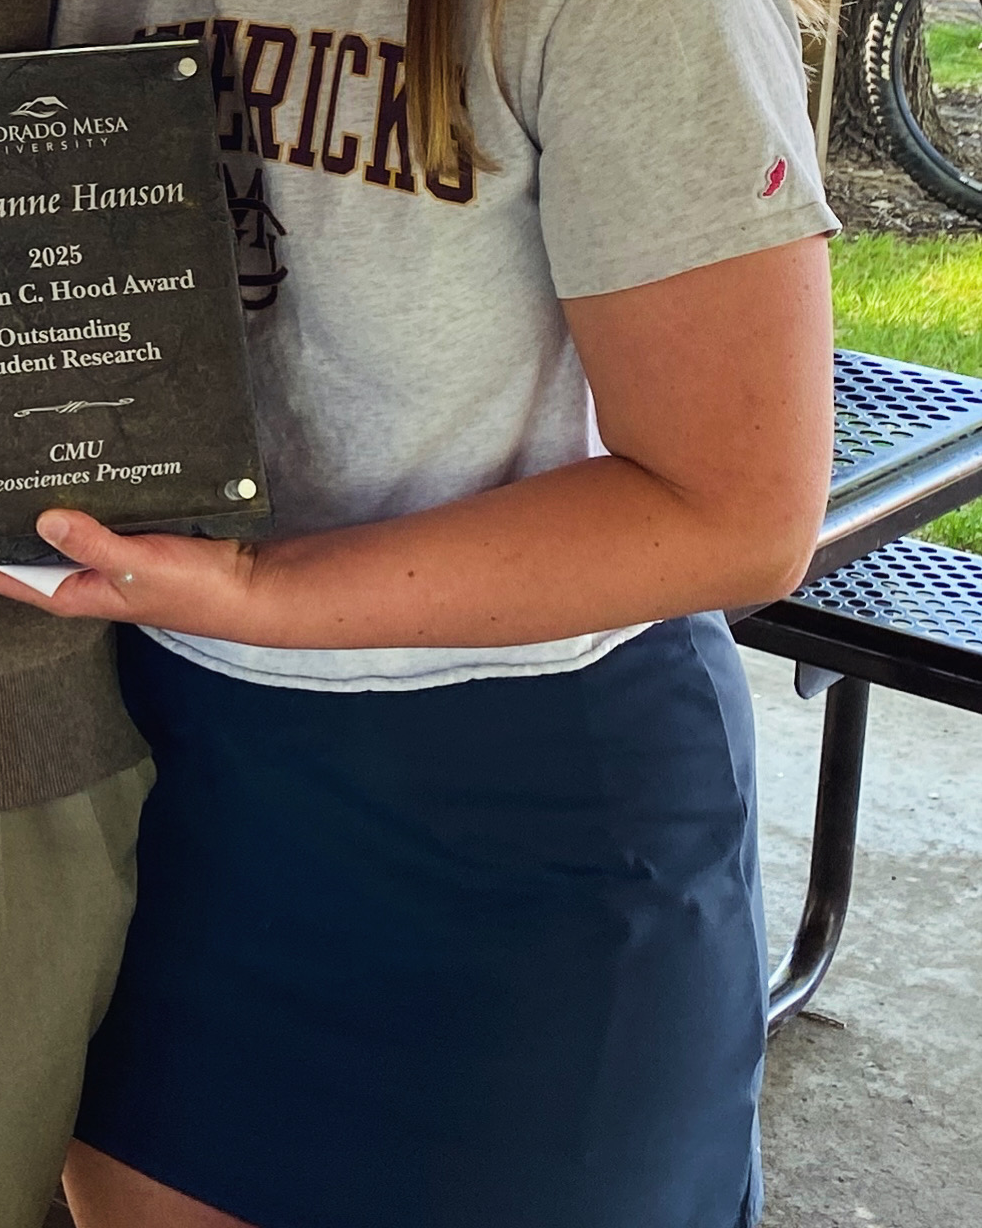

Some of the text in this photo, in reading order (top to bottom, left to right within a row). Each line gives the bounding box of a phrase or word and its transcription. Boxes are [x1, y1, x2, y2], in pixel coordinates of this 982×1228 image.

[73, 116, 129, 136] MESA
[71, 182, 185, 213] Hanson
[28, 244, 83, 269] 2025
[18, 283, 44, 304] C.
[49, 276, 117, 301] Hood
[123, 268, 195, 295] Award
[60, 342, 162, 370] Research
[49, 440, 104, 463] CMU
[95, 461, 182, 485] Program
